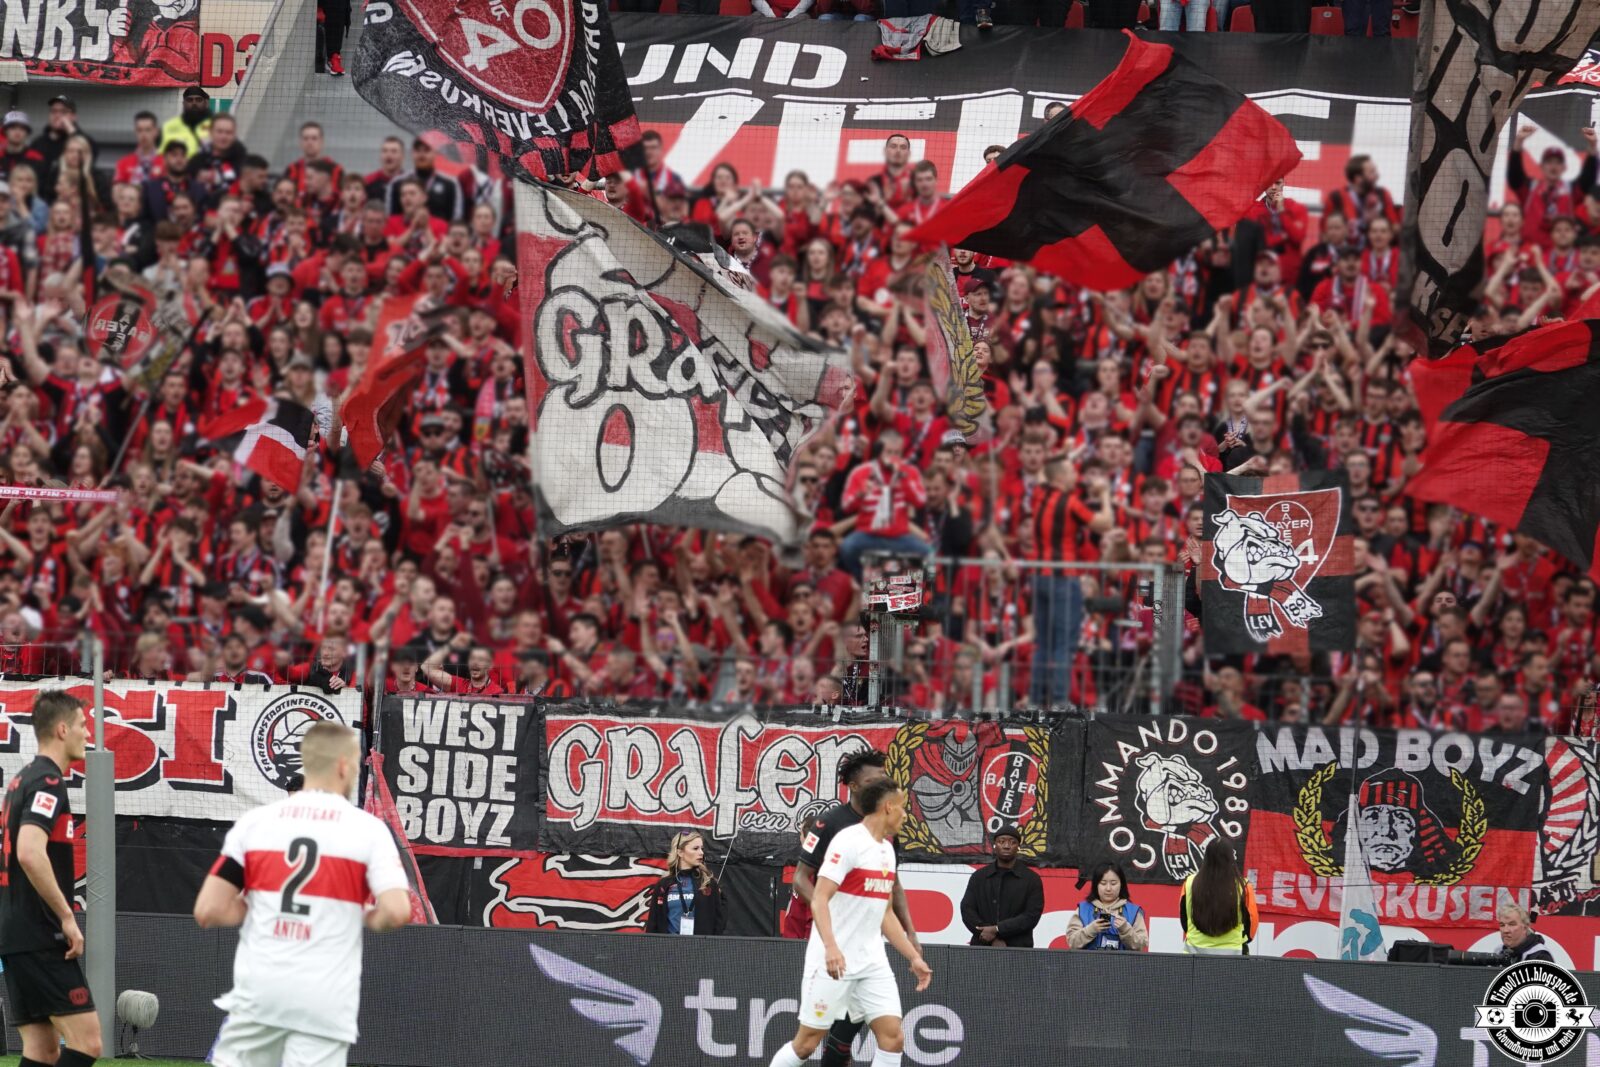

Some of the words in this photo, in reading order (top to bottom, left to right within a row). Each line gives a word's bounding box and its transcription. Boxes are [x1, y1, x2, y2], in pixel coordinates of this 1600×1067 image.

[619, 37, 848, 89] UND
[1250, 614, 1273, 630] LEV
[402, 698, 525, 752] WEST
[397, 746, 517, 802] SIDE
[986, 772, 1037, 796] BAYER
[1001, 755, 1024, 813] BAYER
[1256, 726, 1380, 774] MAD
[1395, 730, 1544, 796] BOYZ
[278, 805, 342, 823] STUTTGART
[1095, 718, 1218, 869] COMMANDO
[1216, 755, 1249, 839] 1989
[396, 795, 516, 847] BOYZ
[740, 811, 791, 832] von
[280, 837, 319, 916] 2
[1168, 854, 1190, 870] LEV
[273, 919, 312, 941] ANTON
[684, 979, 965, 1066] tre
